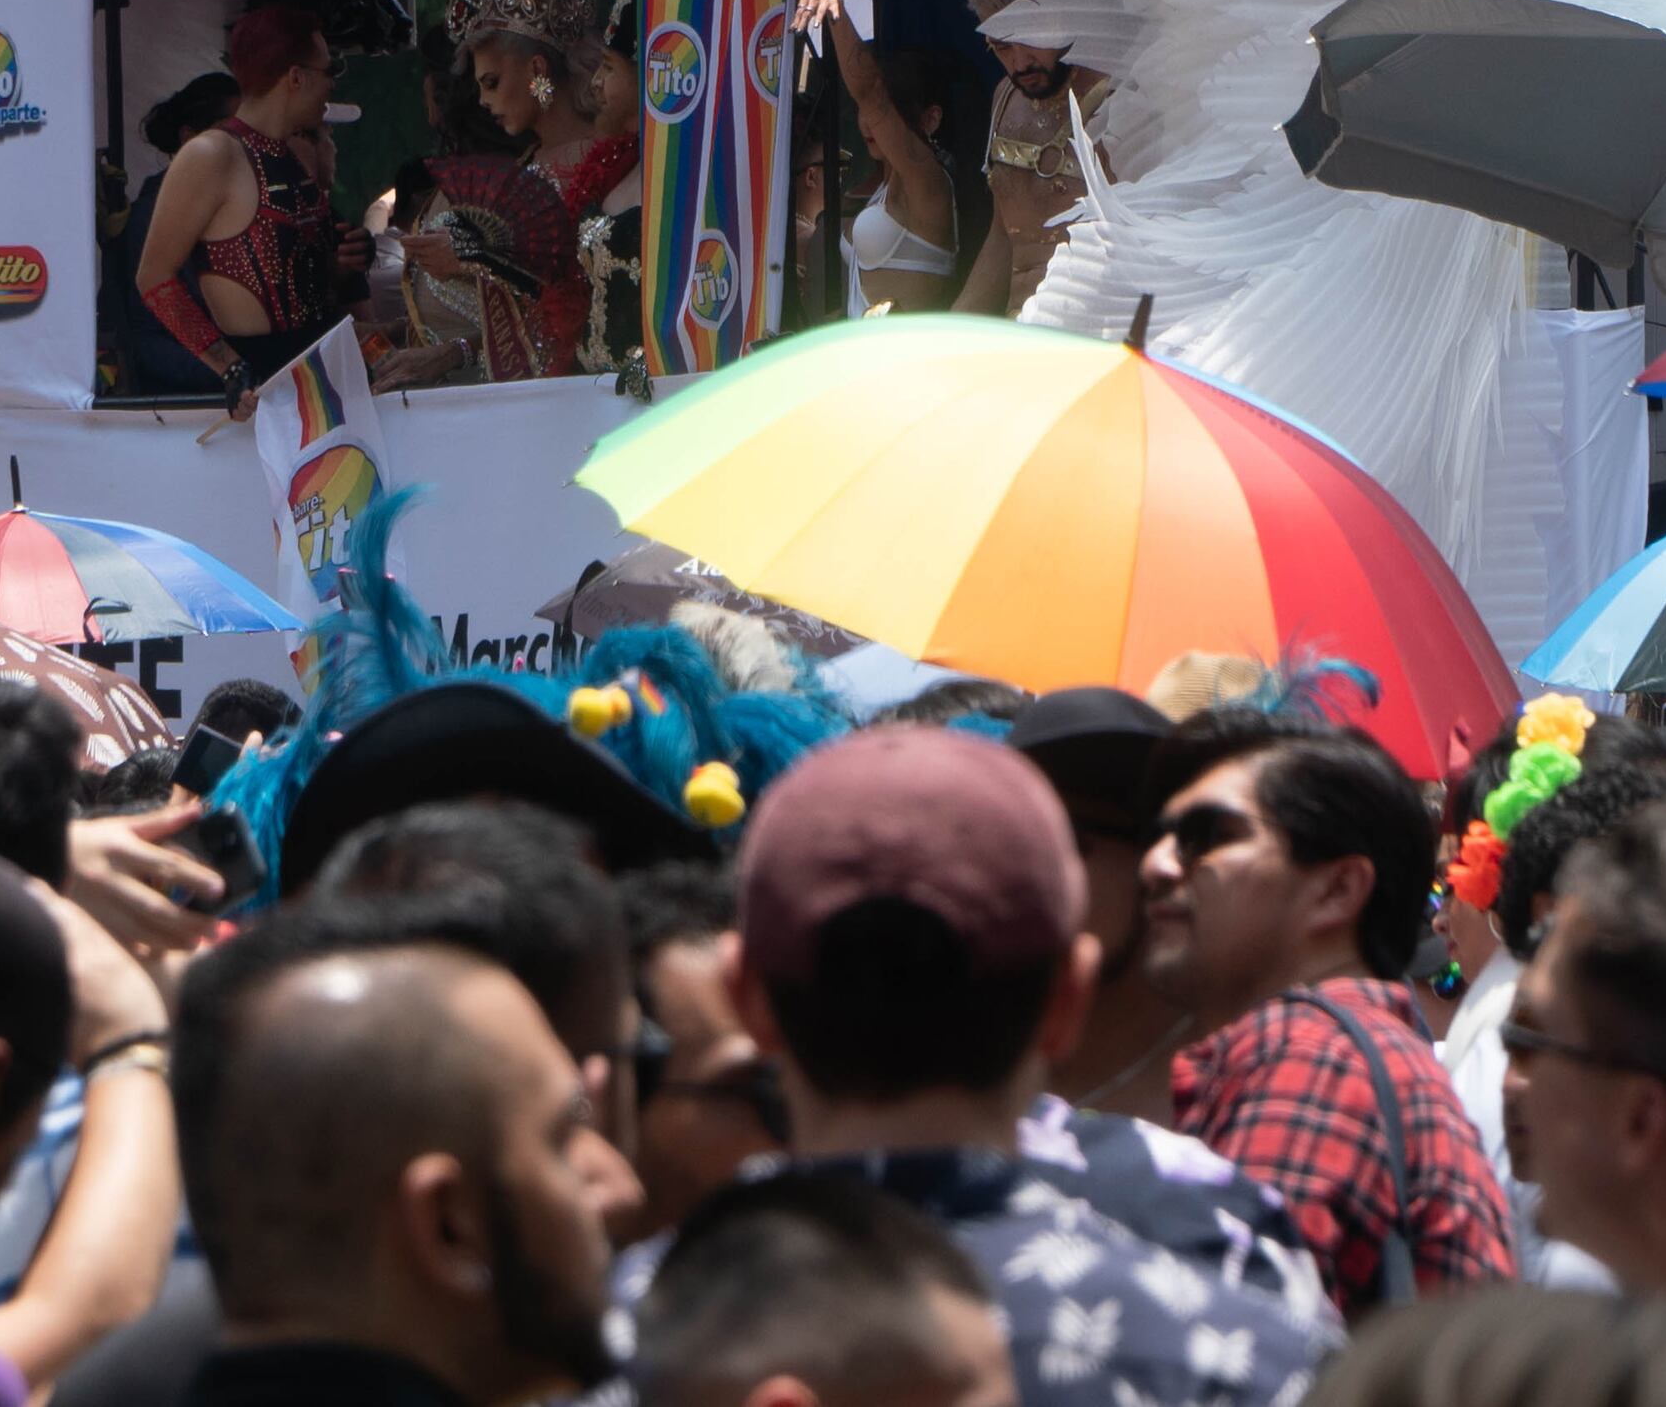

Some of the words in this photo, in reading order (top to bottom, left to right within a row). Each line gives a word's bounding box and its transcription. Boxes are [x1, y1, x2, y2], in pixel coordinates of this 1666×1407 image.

[649, 60, 697, 97] Tito
[761, 47, 783, 81] Ti
[425, 611, 597, 676] March
